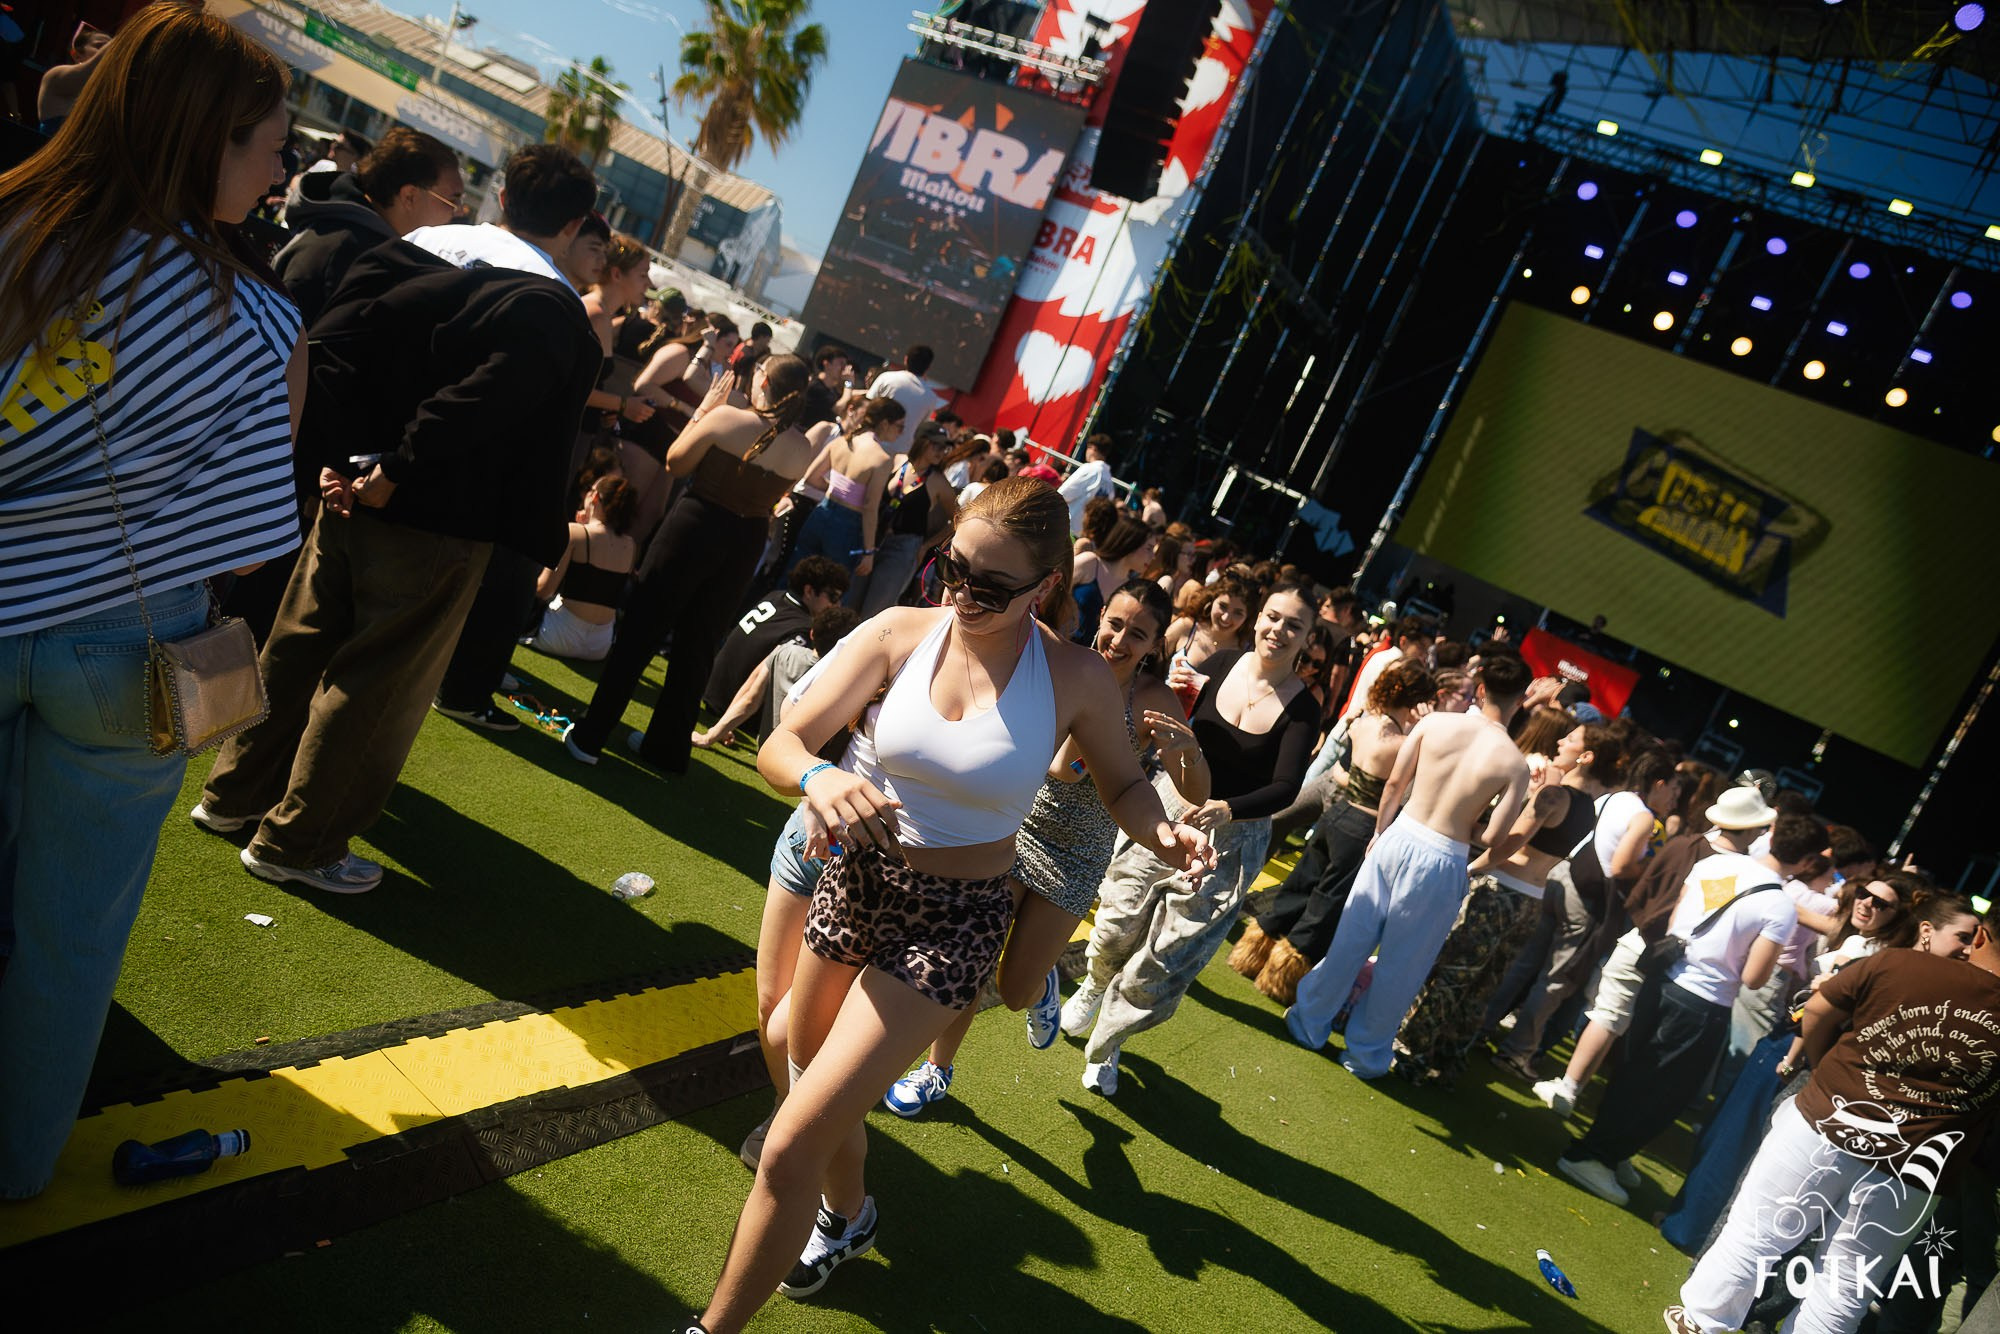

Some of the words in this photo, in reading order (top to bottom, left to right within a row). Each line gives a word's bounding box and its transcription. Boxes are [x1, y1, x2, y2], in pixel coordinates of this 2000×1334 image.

[1898, 1004, 1931, 1020] born
[1935, 1000, 1951, 1021] of
[1953, 1009, 2000, 1036] endless
[1869, 1046, 1891, 1063] by
[1886, 1031, 1906, 1050] the
[1906, 1021, 1944, 1040] wind,
[1949, 1029, 1987, 1048] and
[1921, 1041, 1941, 1063] by
